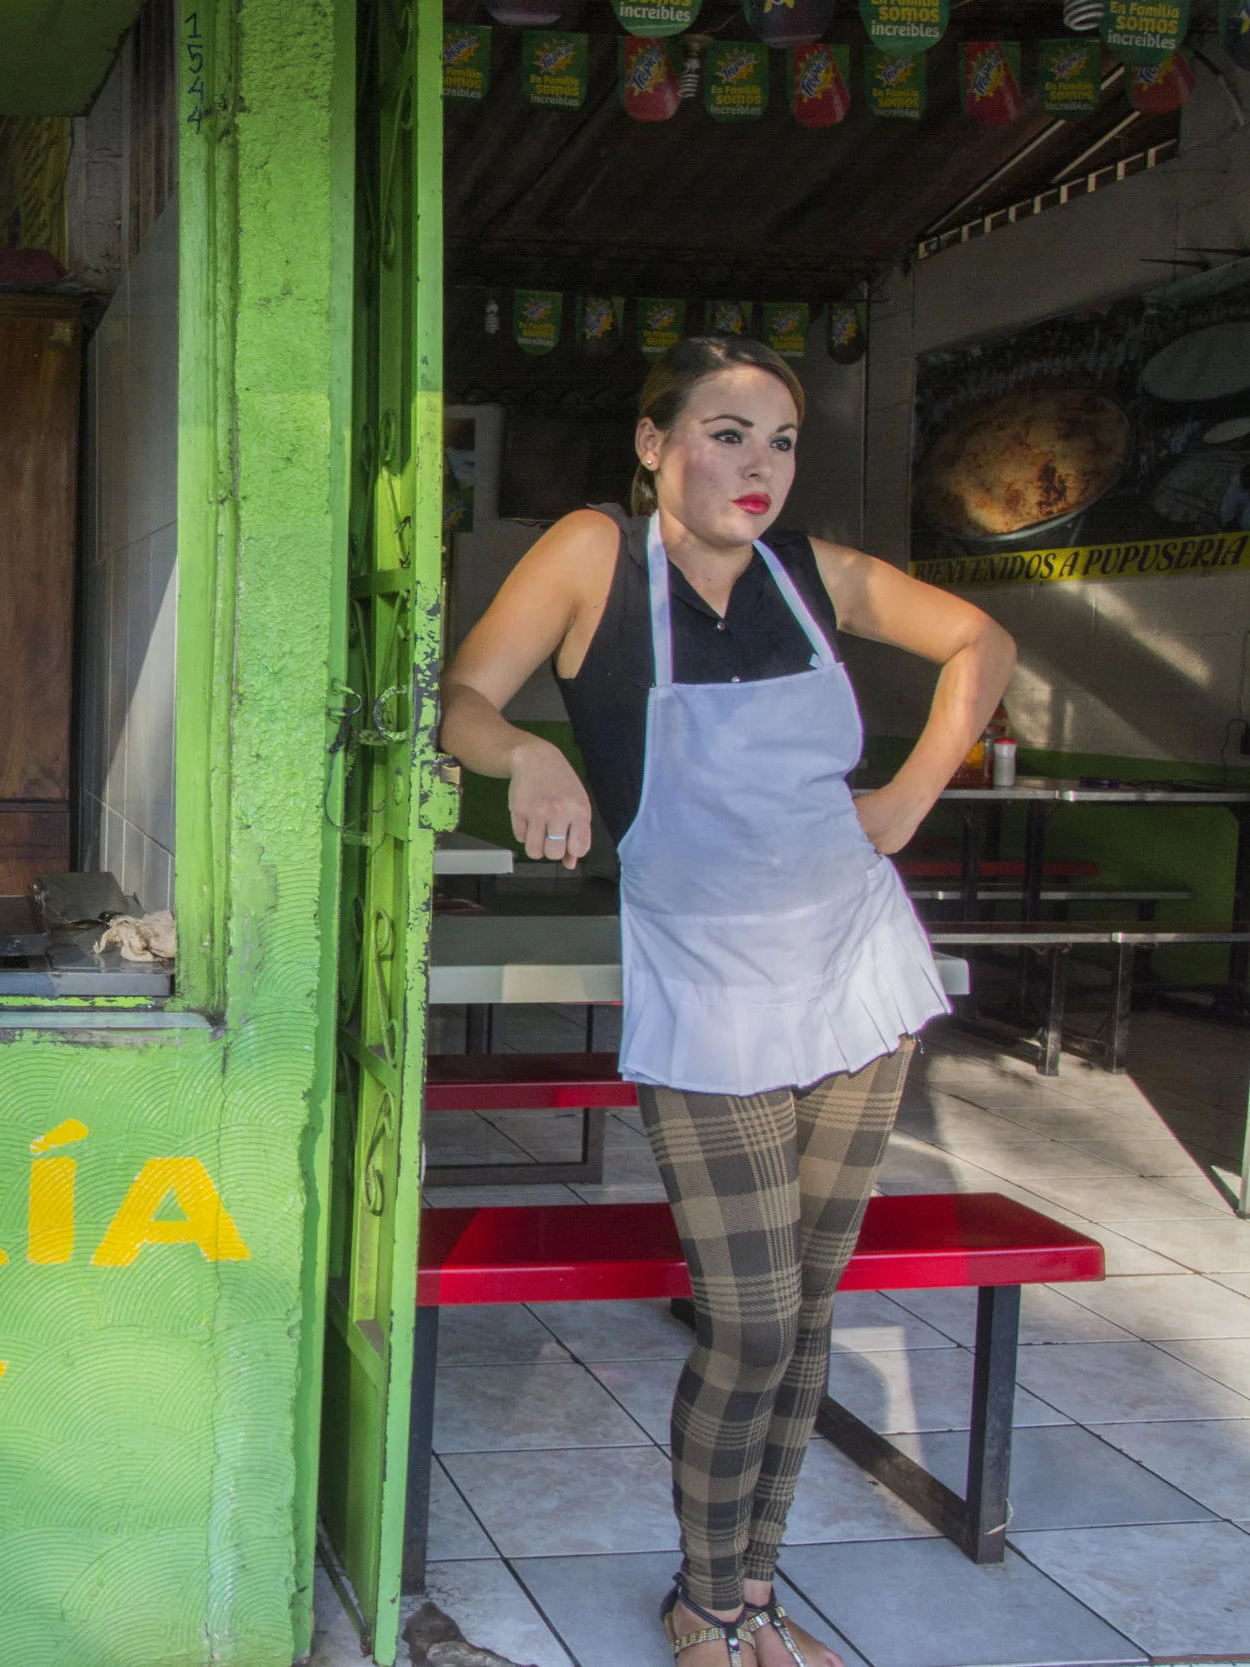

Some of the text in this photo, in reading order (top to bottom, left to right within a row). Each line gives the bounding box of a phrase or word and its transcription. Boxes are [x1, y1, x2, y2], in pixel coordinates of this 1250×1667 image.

[879, 6, 940, 23] somos
[1110, 1, 1180, 18] En Familia
[1116, 15, 1178, 34] somos
[1108, 30, 1176, 50] increíbles
[914, 535, 1248, 584] BIENVENIDOS A PUPUSERIA
